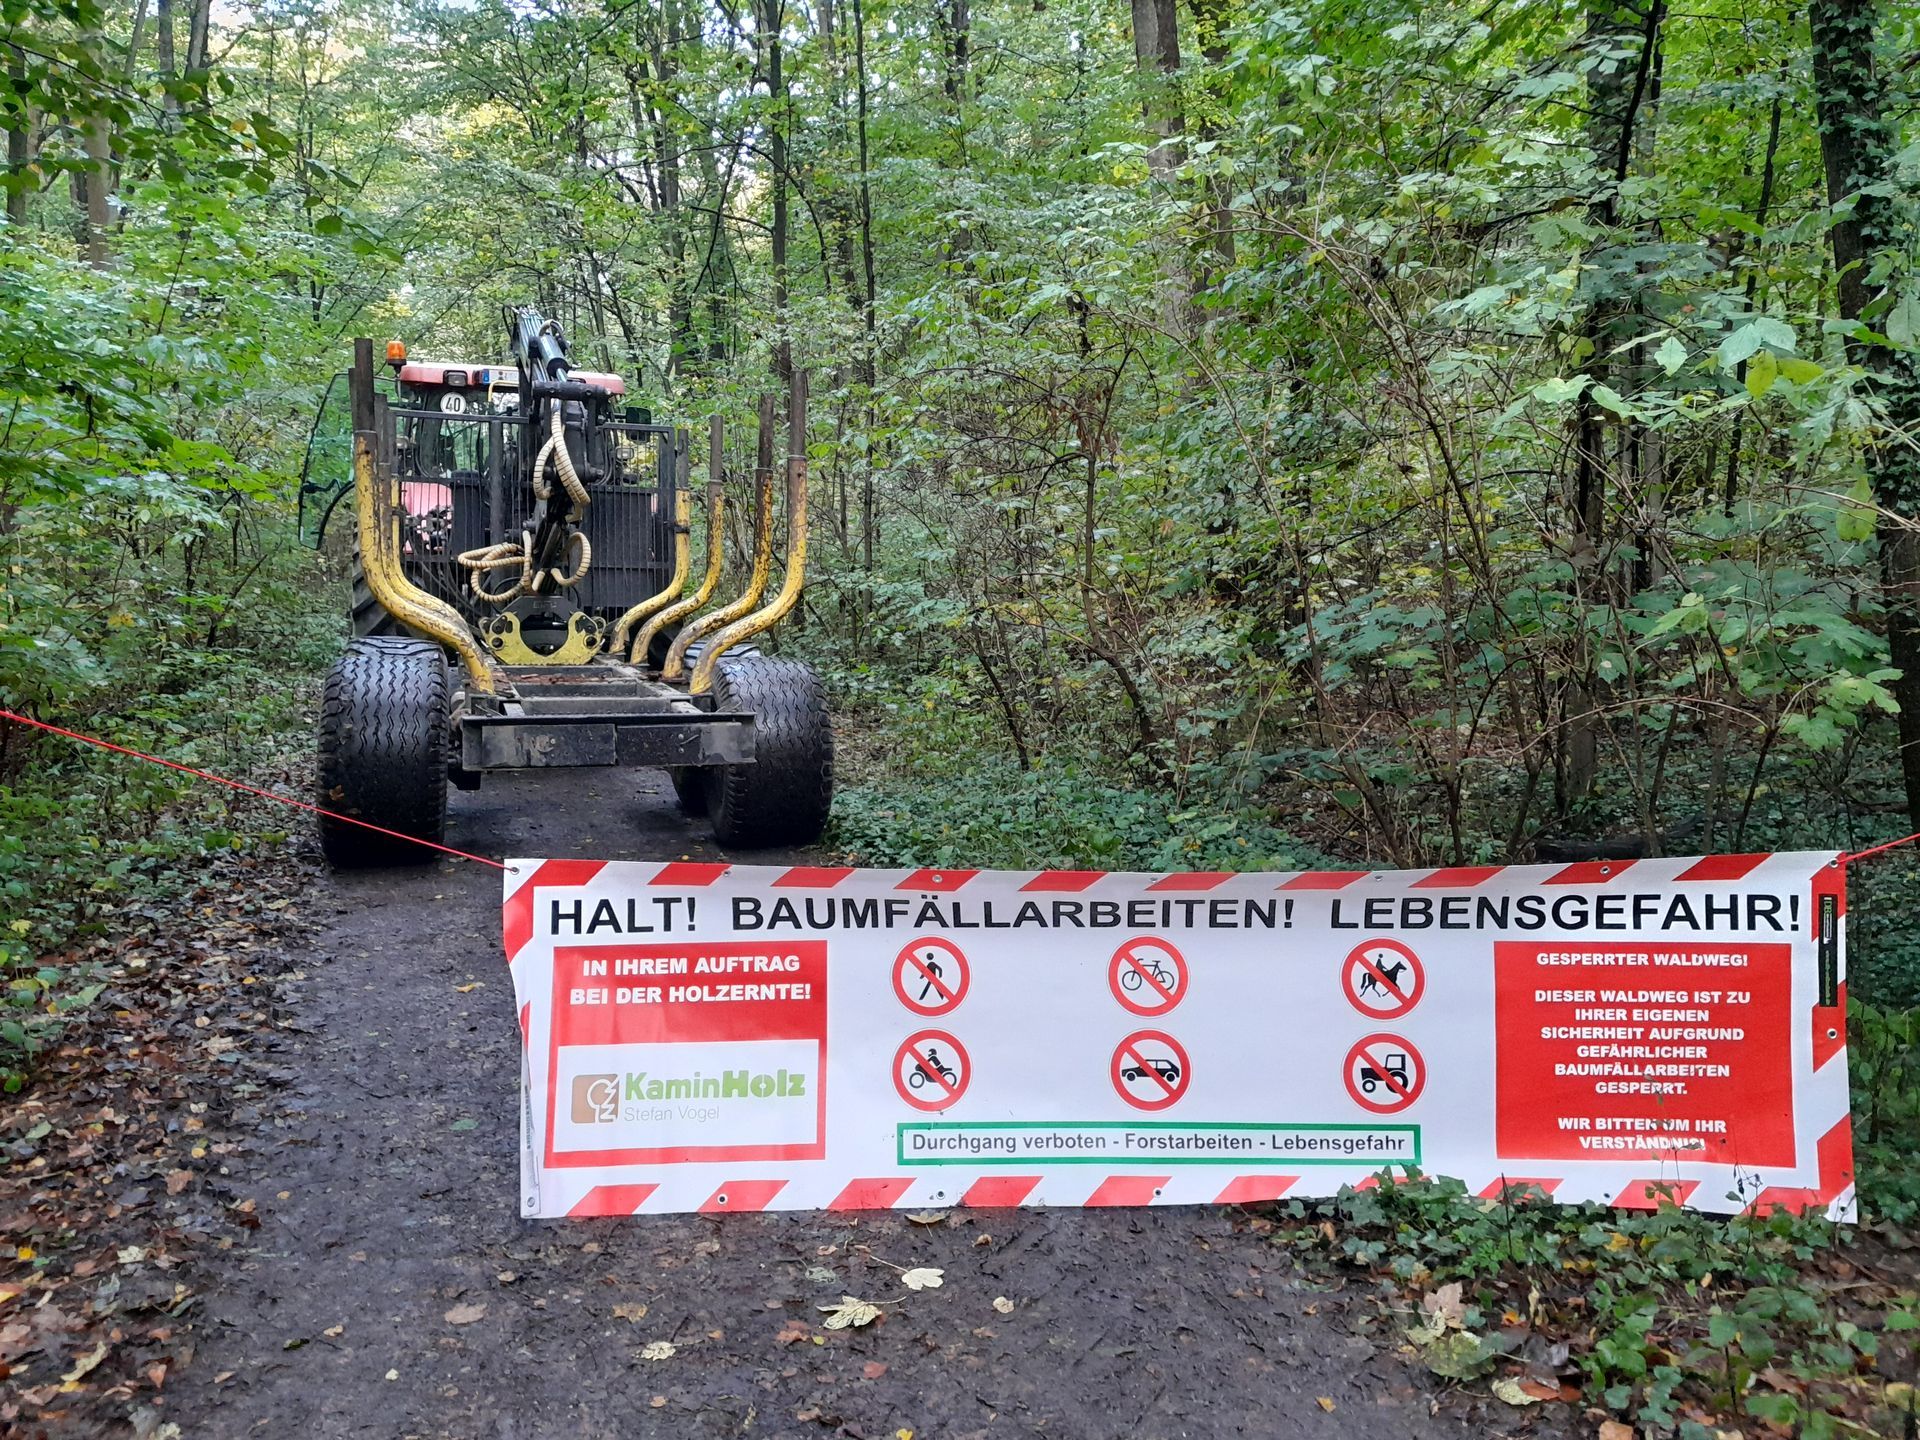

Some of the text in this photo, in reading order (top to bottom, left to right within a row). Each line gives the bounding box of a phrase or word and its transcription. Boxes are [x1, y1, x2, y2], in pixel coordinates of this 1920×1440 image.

[444, 396, 462, 411] 40
[550, 896, 697, 935] HALT!
[731, 895, 1293, 931] BAUMFÄLLARBEITEN!
[1331, 893, 1800, 931] LEBENSGEFAHR!
[583, 955, 800, 976] IN IHREM AUFTRAG
[1536, 953, 1748, 967] GESPERRTER WALDWEG!
[570, 984, 811, 1005] BEI DER HOLZERNTE!
[1535, 990, 1750, 1004] DIESER WALDWEG IST ZU
[1575, 1008, 1710, 1022] IHRER EIGENEN
[1540, 1027, 1745, 1041] SICHERHEIT AUFGRUND
[1576, 1043, 1708, 1059] GEFÄHRLICHER
[1554, 1061, 1730, 1077] BAUMFÄLLARBEITEN
[625, 1069, 806, 1101] KaminHolz
[1595, 1081, 1688, 1095] GESPERRT.
[624, 1105, 720, 1122] Stefan Vogel
[1557, 1117, 1591, 1130] WIR
[1694, 1119, 1727, 1133] IHR
[912, 1134, 1017, 1153] Durchgang
[1023, 1133, 1106, 1149] verboten
[1125, 1133, 1252, 1149] Forstarbeiten
[1271, 1134, 1406, 1154] Lebensgefahr
